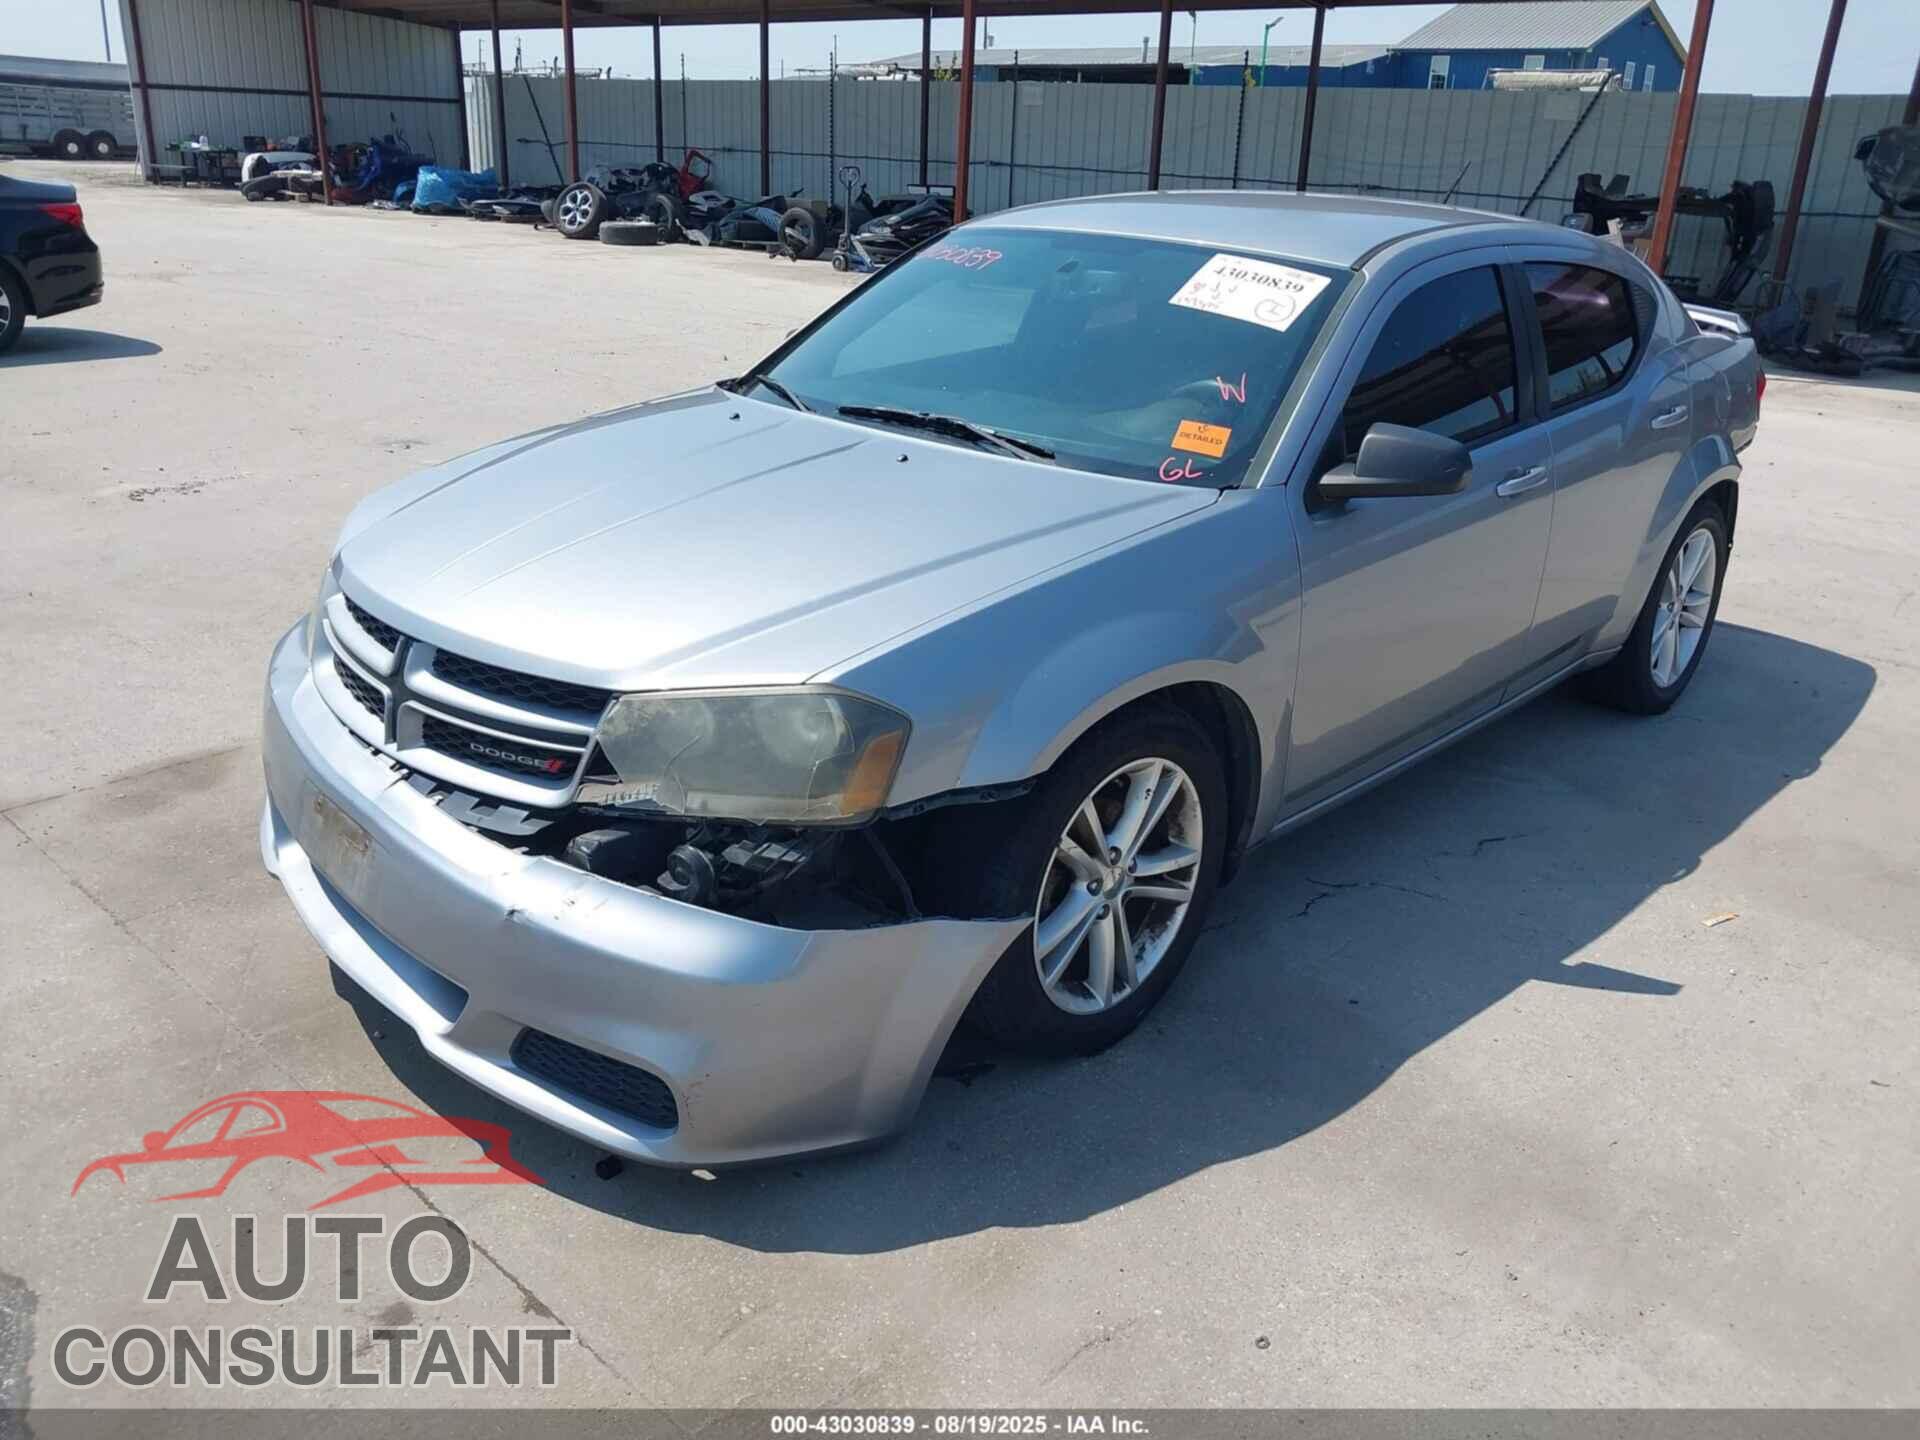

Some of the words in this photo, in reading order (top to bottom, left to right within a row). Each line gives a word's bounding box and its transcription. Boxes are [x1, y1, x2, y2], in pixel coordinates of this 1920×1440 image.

[1214, 266, 1306, 293] 43030839
[1179, 430, 1223, 446] DETAILED
[470, 742, 547, 768] DODGE
